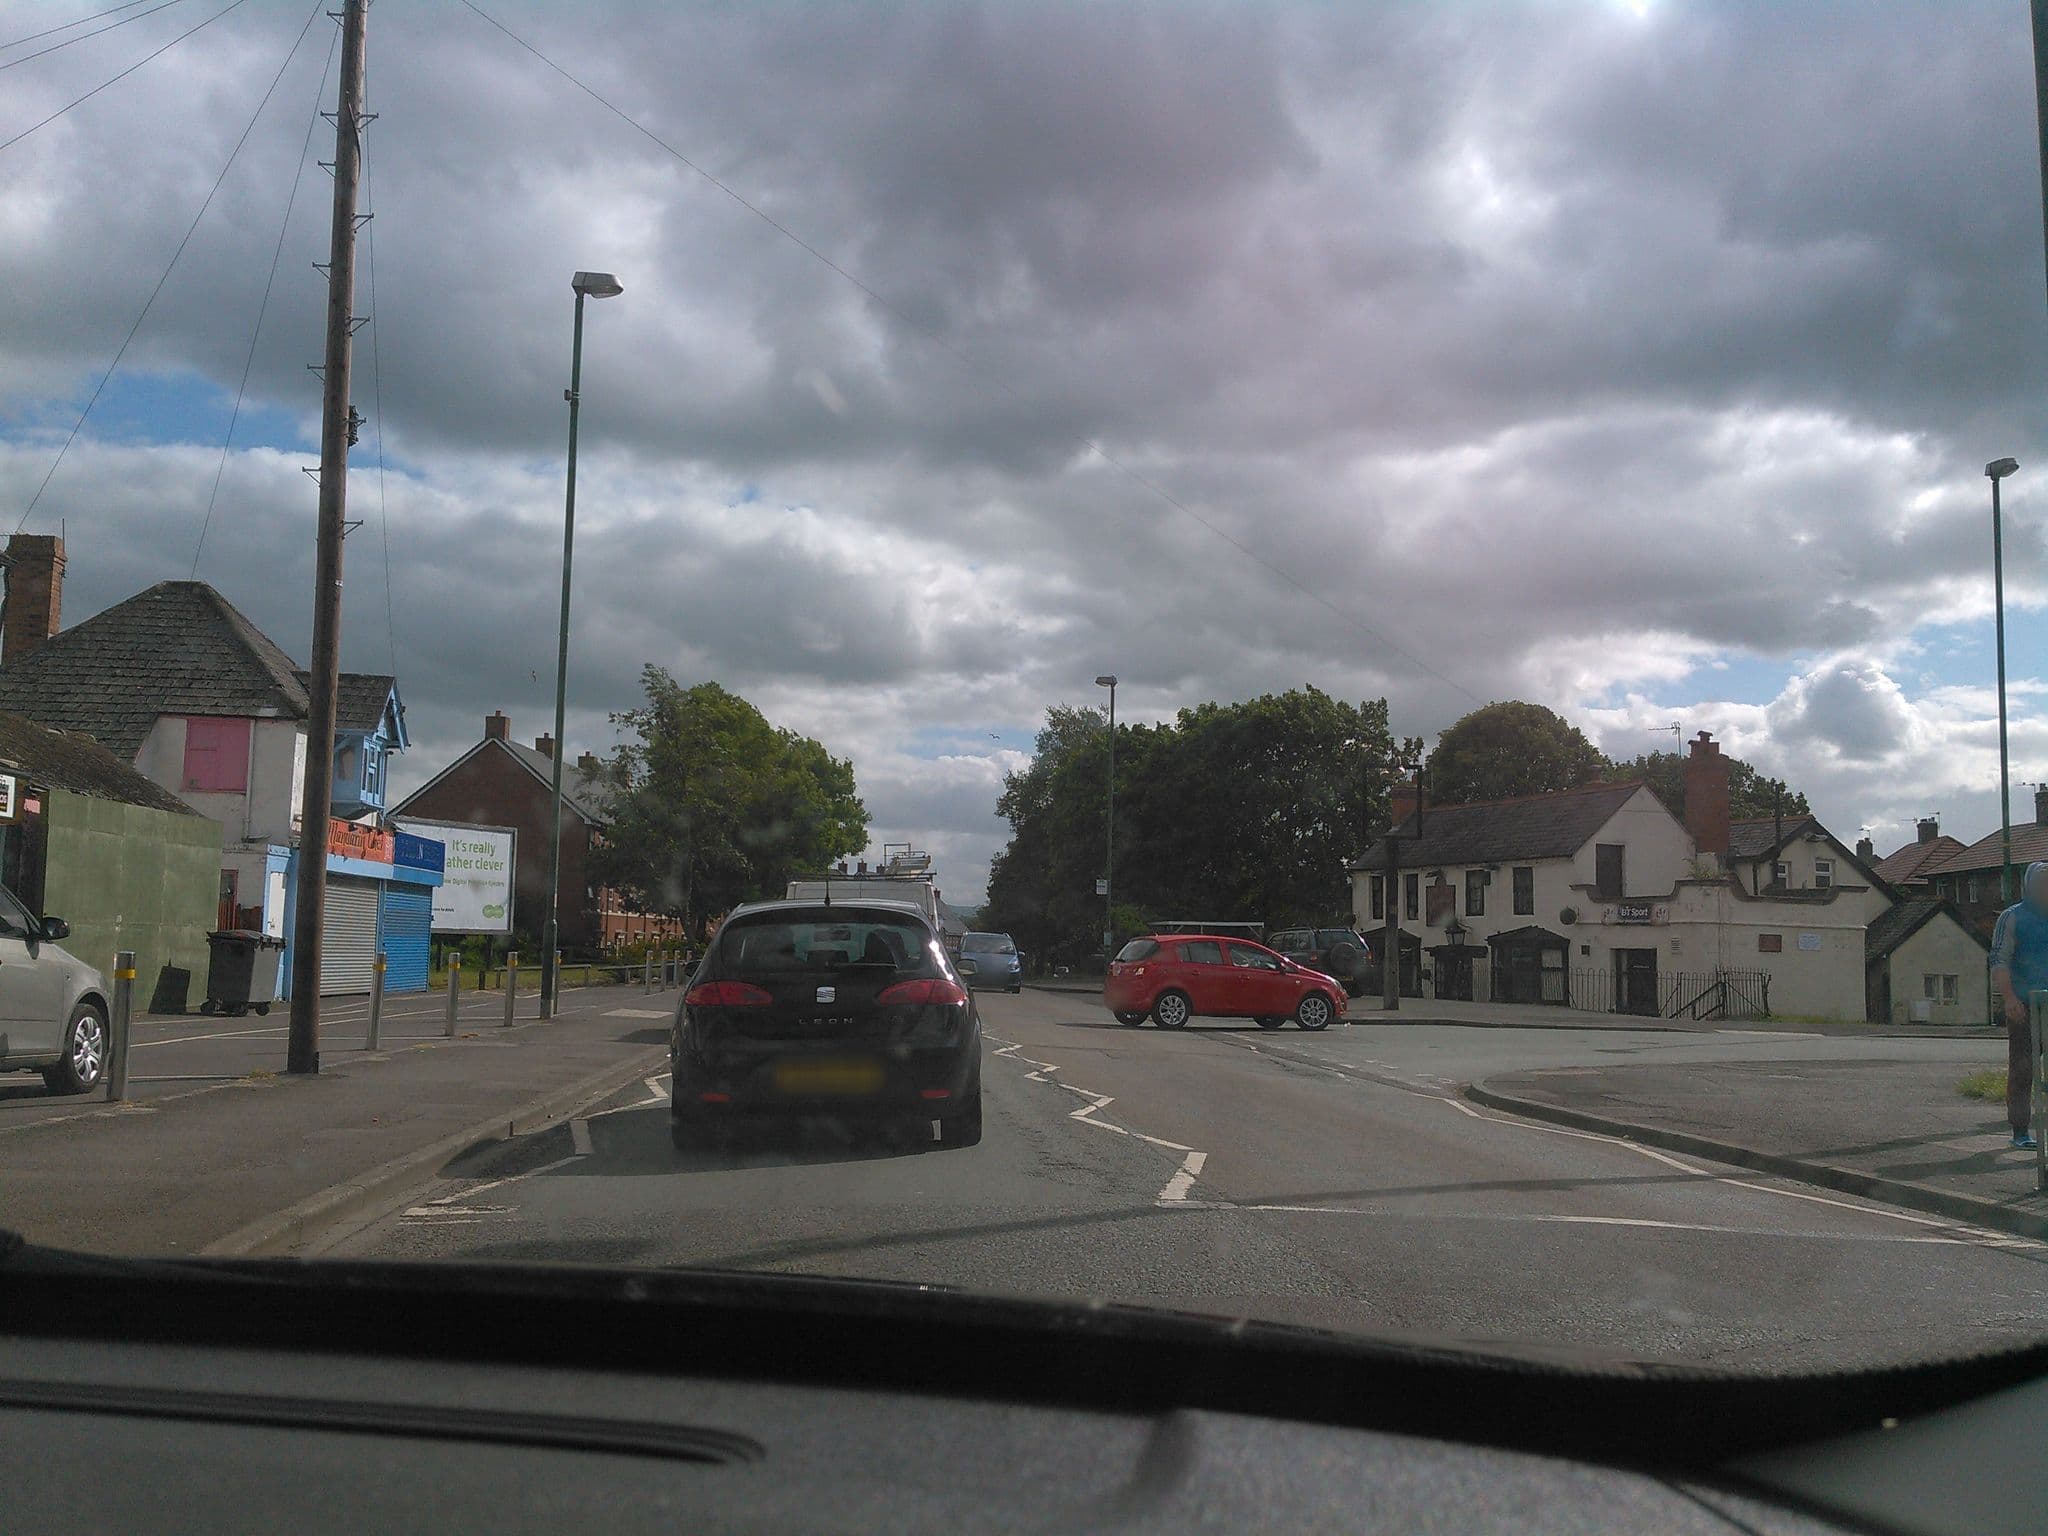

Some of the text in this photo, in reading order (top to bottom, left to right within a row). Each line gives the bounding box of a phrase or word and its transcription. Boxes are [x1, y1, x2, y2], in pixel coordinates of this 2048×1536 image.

[452, 840, 467, 852] It's
[469, 841, 495, 857] really
[447, 856, 504, 871] ather clever
[1632, 907, 1648, 918] Sport
